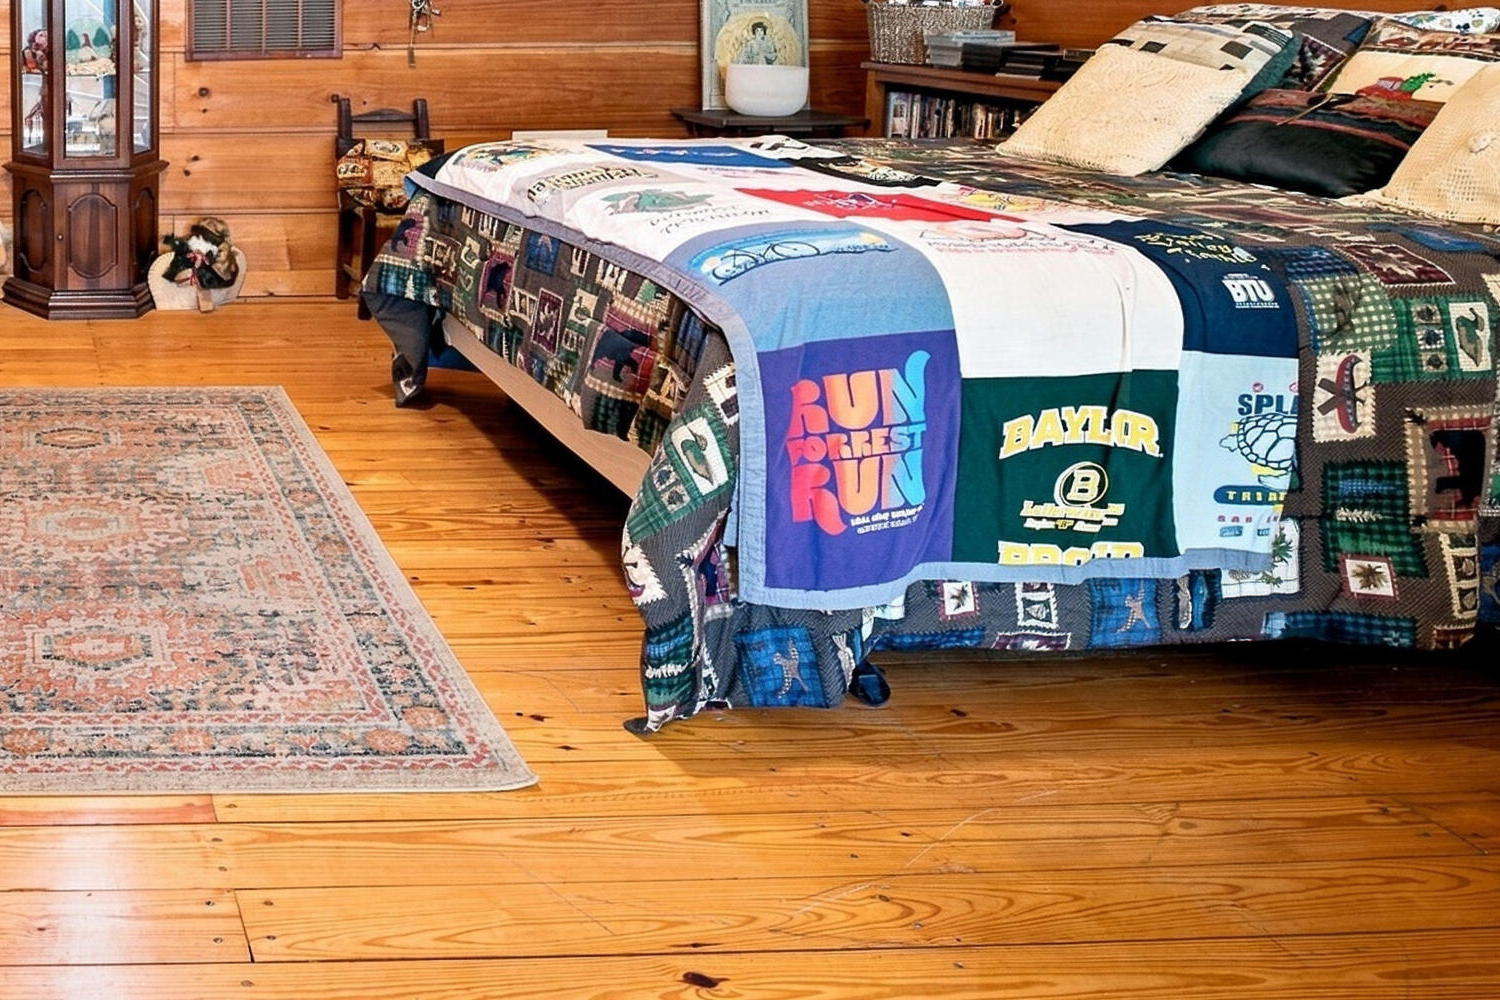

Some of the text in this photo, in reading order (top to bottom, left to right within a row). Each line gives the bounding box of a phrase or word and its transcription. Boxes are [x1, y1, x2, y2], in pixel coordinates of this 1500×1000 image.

[787, 350, 931, 439] RUN
[786, 423, 928, 467] FORREST
[998, 404, 1161, 460] BAYLOR
[791, 448, 928, 536] RUN
[1067, 469, 1100, 502] B
